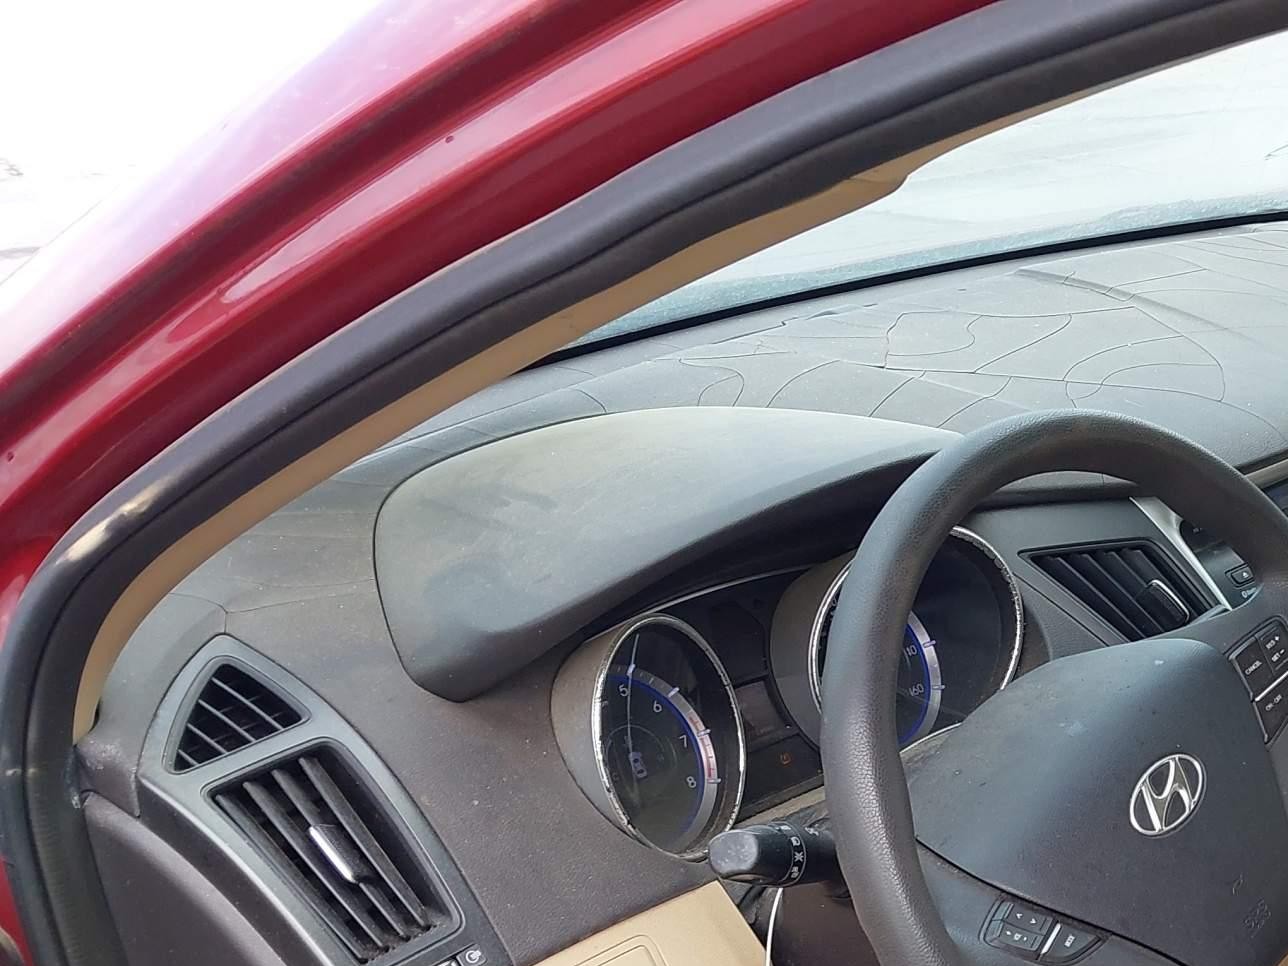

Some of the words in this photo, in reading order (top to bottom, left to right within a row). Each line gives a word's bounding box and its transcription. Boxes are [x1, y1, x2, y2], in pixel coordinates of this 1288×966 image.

[619, 684, 629, 697] 5
[653, 700, 662, 713] 6
[680, 735, 688, 748] 7
[686, 776, 696, 788] 8
